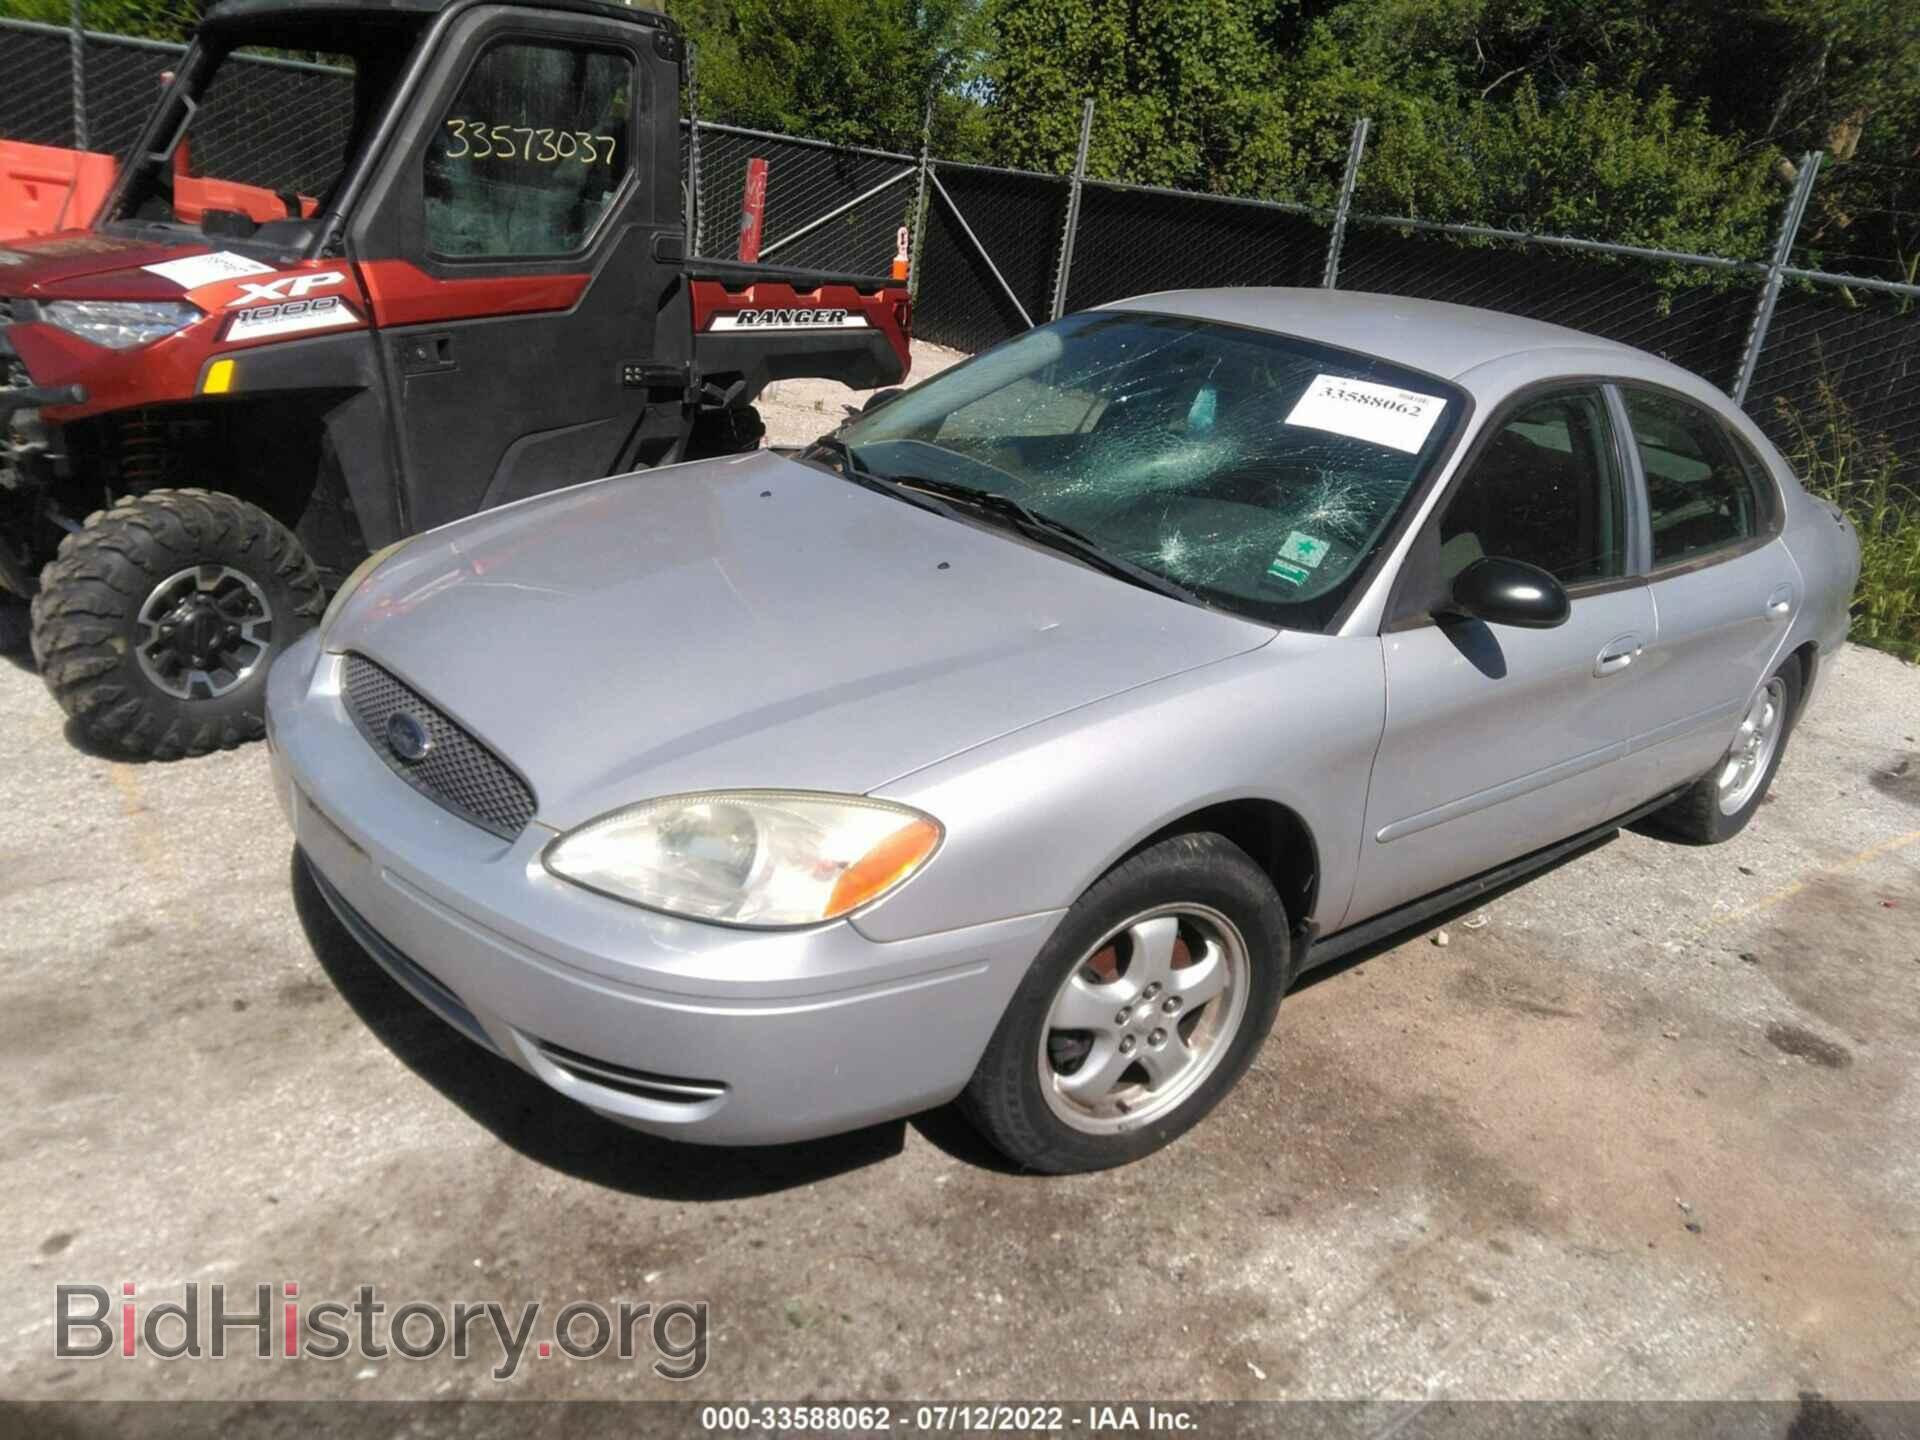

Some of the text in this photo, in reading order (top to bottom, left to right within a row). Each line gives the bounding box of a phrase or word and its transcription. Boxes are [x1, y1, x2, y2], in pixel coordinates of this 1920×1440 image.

[446, 119, 616, 165] 33573037
[224, 271, 346, 307] XP
[236, 296, 340, 323] 1000
[736, 309, 848, 326] RANGER
[1318, 386, 1422, 416] 33588062
